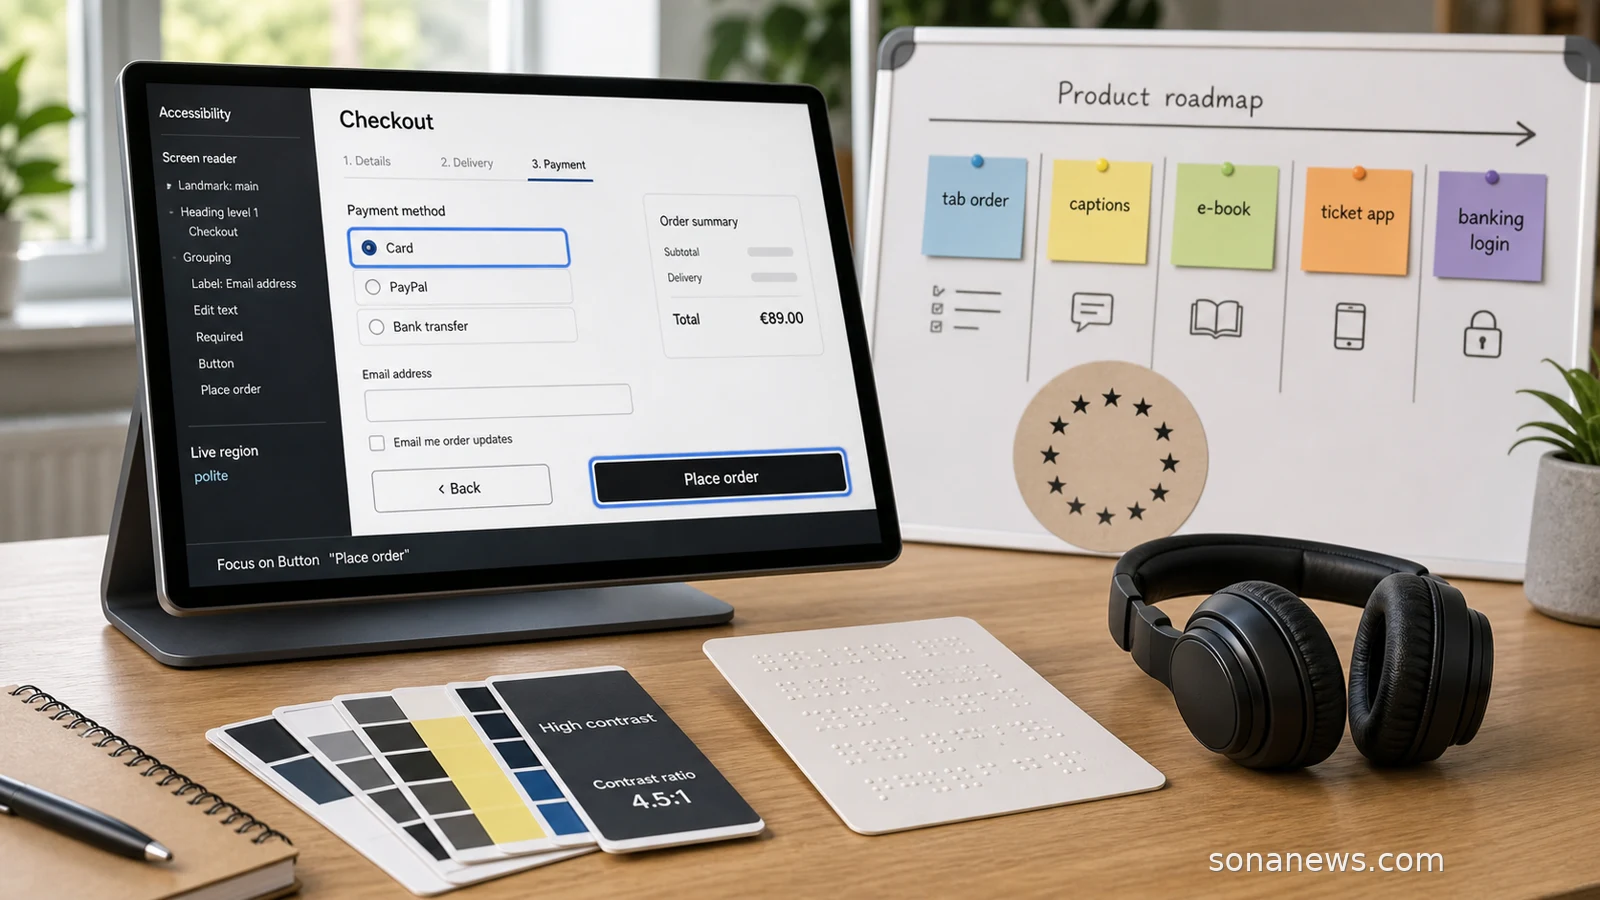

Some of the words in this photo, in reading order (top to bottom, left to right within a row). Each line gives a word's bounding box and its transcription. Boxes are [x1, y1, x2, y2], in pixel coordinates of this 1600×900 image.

[1058, 80, 1151, 107] Product
[1165, 85, 1264, 118] roadmap
[159, 106, 232, 123] Accessibility
[339, 109, 435, 131] Checkout
[162, 151, 200, 164] Screen
[202, 152, 238, 164] reader
[343, 155, 353, 166] 1.
[355, 155, 392, 167] Details
[440, 156, 451, 168] 2.
[453, 157, 494, 171] Delivery
[531, 158, 542, 170] 3.
[543, 158, 587, 172] Payment
[178, 179, 233, 191] Landmark:
[234, 180, 259, 192] main
[941, 190, 966, 206] tab
[970, 191, 1010, 208] order
[1069, 197, 1131, 216] captions
[180, 206, 225, 220] Heading
[227, 206, 251, 218] level
[253, 207, 259, 218] 1
[347, 204, 400, 219] Payment
[401, 204, 446, 217] method
[1197, 199, 1251, 217] e-book
[1320, 204, 1363, 220] ticket
[1367, 209, 1395, 226] app
[659, 214, 690, 227] Order
[691, 218, 739, 230] summary
[1458, 207, 1524, 232] banking
[188, 225, 239, 237] Checkout
[385, 241, 414, 254] Card
[663, 246, 700, 257] Subtotal
[1470, 233, 1510, 256] login
[182, 251, 232, 266] Grouping
[191, 278, 223, 289] Label:
[225, 277, 254, 289] Email
[256, 278, 297, 289] address
[667, 272, 703, 285] Delivery
[389, 280, 428, 296] PayPal
[193, 304, 215, 316] Edit
[217, 305, 239, 316] text
[672, 312, 701, 326] Total
[759, 311, 804, 325] €89.00
[393, 320, 423, 333] Bank
[424, 319, 469, 332] transfer
[196, 331, 244, 345] Required
[198, 358, 235, 369] Button
[362, 368, 391, 380] Email
[392, 368, 433, 380] address
[200, 384, 231, 396] Place
[232, 383, 262, 395] order
[393, 436, 422, 448] Email
[424, 438, 441, 447] me
[442, 435, 471, 447] order
[472, 434, 513, 447] updates
[190, 446, 217, 459] Live
[219, 444, 259, 461] region
[194, 469, 229, 486] polite
[684, 471, 721, 486] Place
[723, 469, 759, 484] order
[450, 481, 482, 495] Back
[217, 558, 256, 571] Focus
[258, 558, 275, 569] on
[277, 555, 320, 568] Button
[538, 720, 583, 734] High
[585, 713, 658, 729] contrast
[592, 774, 660, 790] Contrast
[660, 770, 696, 782] ratio
[632, 789, 692, 809] 4.5:1
